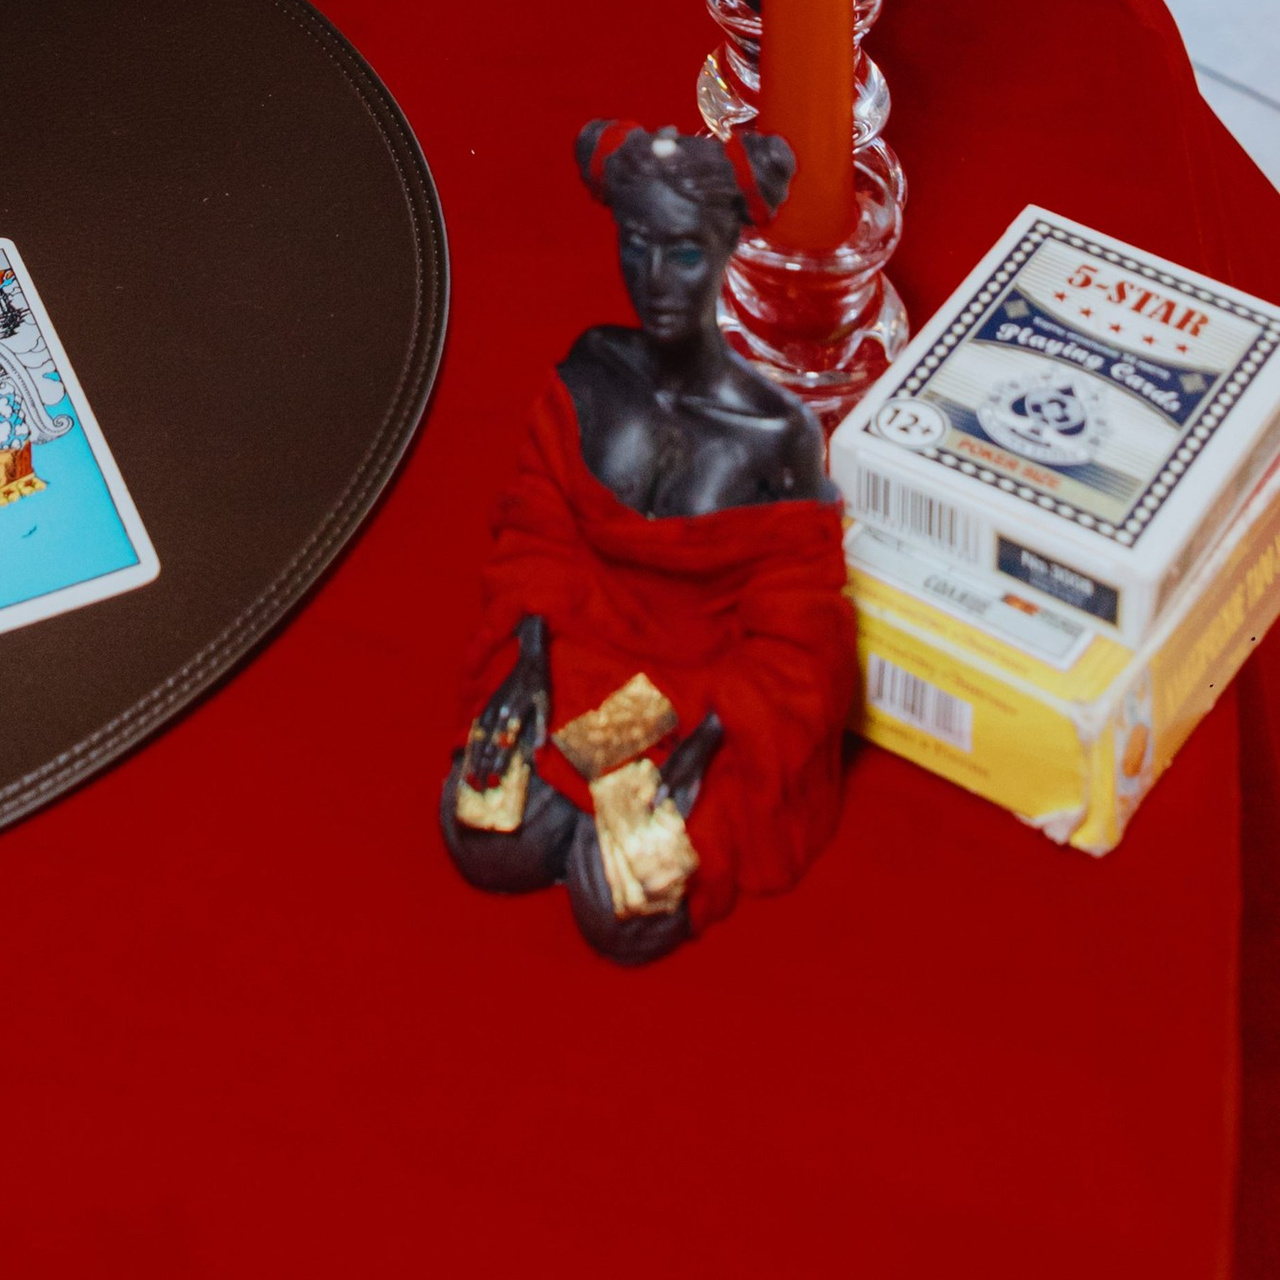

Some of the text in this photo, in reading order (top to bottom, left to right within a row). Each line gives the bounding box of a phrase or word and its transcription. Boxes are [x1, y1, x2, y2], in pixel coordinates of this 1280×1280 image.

[1067, 264, 1209, 337] 5-STAR
[996, 323, 1104, 369] Playing
[1110, 362, 1181, 412] Cards
[886, 407, 932, 435] 12+
[958, 437, 1019, 472] POKER
